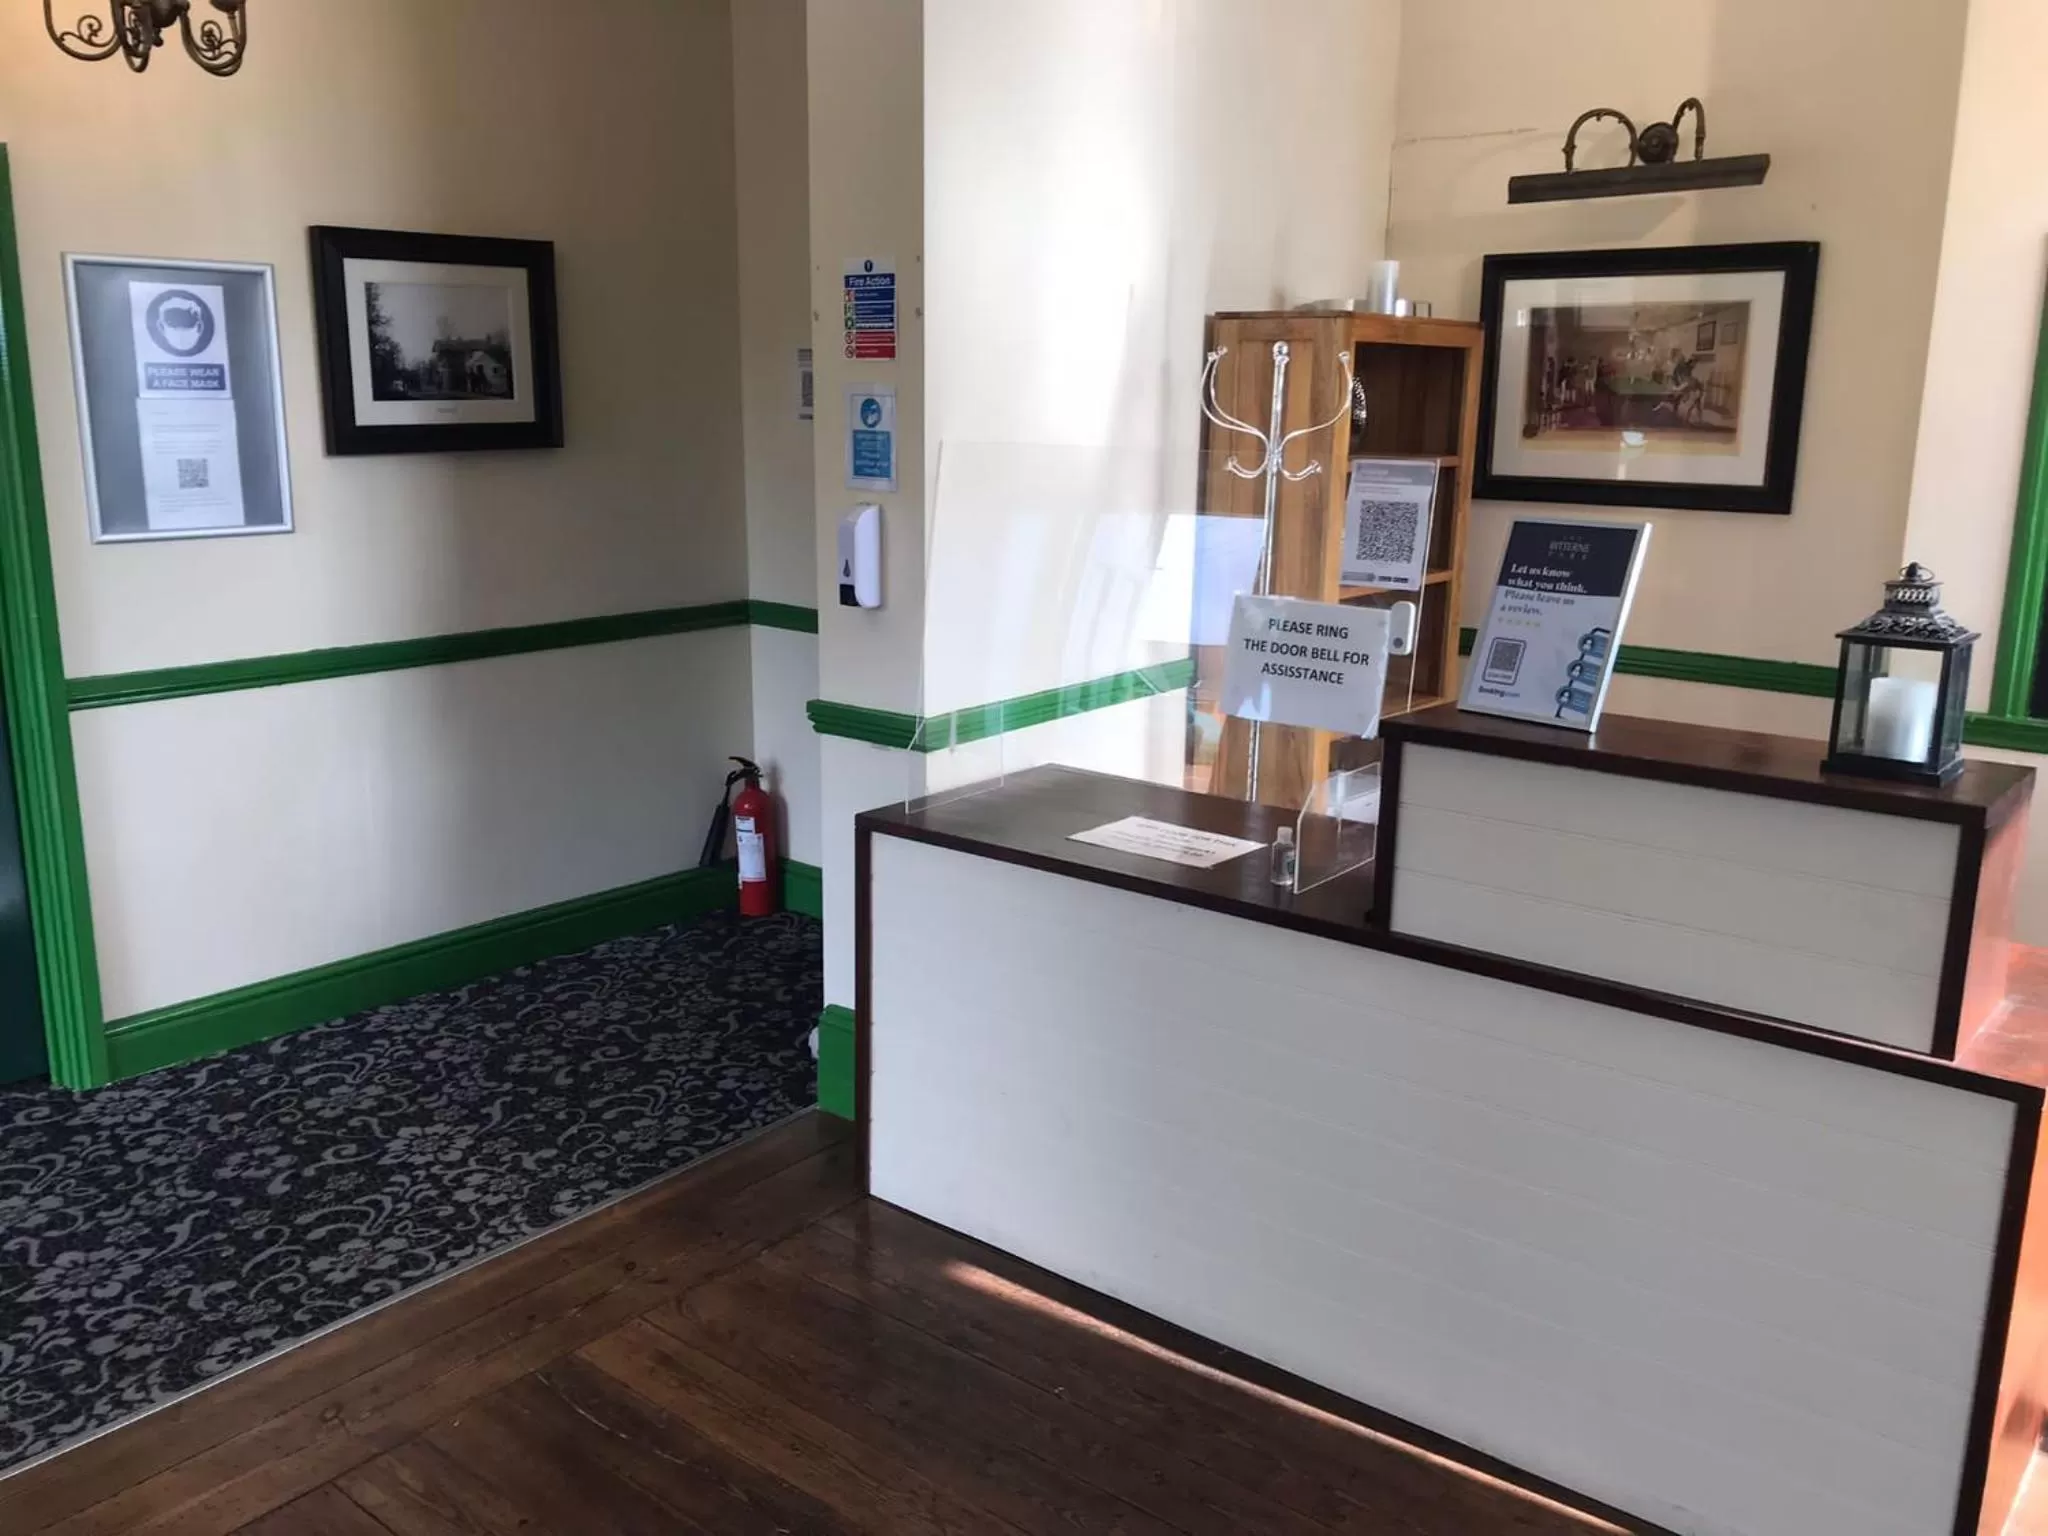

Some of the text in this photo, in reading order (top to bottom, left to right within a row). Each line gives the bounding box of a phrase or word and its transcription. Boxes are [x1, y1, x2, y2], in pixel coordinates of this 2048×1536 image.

[848, 276, 892, 287] Fire Action
[147, 366, 187, 377] PLEASE
[1510, 563, 1572, 578] Let us know
[1507, 578, 1588, 594] what you think.
[1504, 589, 1576, 606] Please leave us
[1268, 618, 1349, 640] PLEASE RING
[1244, 638, 1370, 667] THE DOOR BELL FOR
[1260, 662, 1345, 686] ASSISSTANCE
